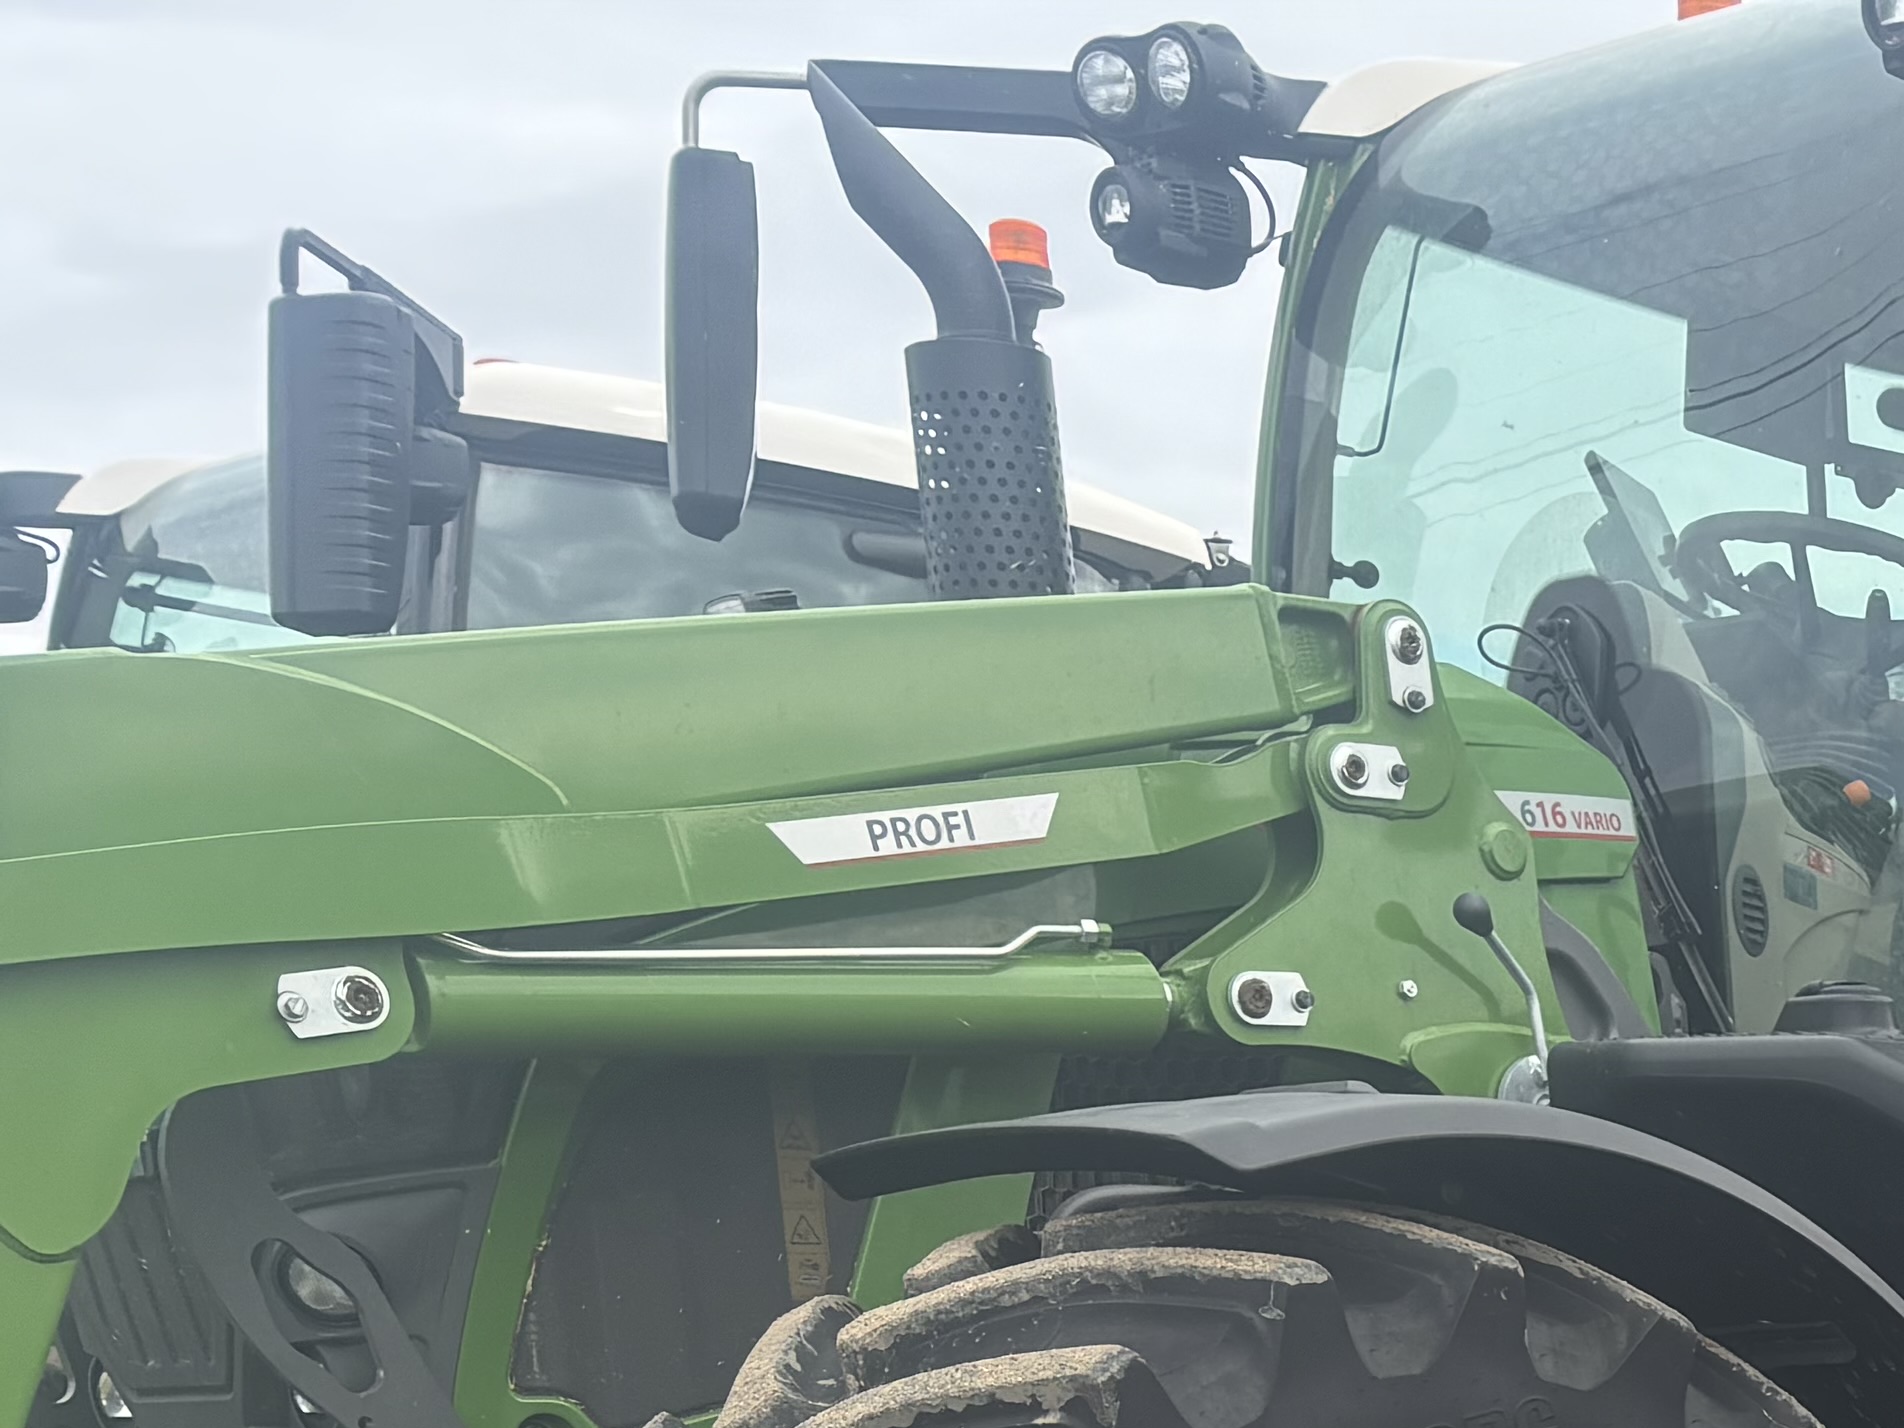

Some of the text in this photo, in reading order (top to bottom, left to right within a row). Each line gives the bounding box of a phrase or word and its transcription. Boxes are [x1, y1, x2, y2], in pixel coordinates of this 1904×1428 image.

[866, 809, 976, 852] PROFI
[1520, 799, 1622, 832] 616 VARIO
